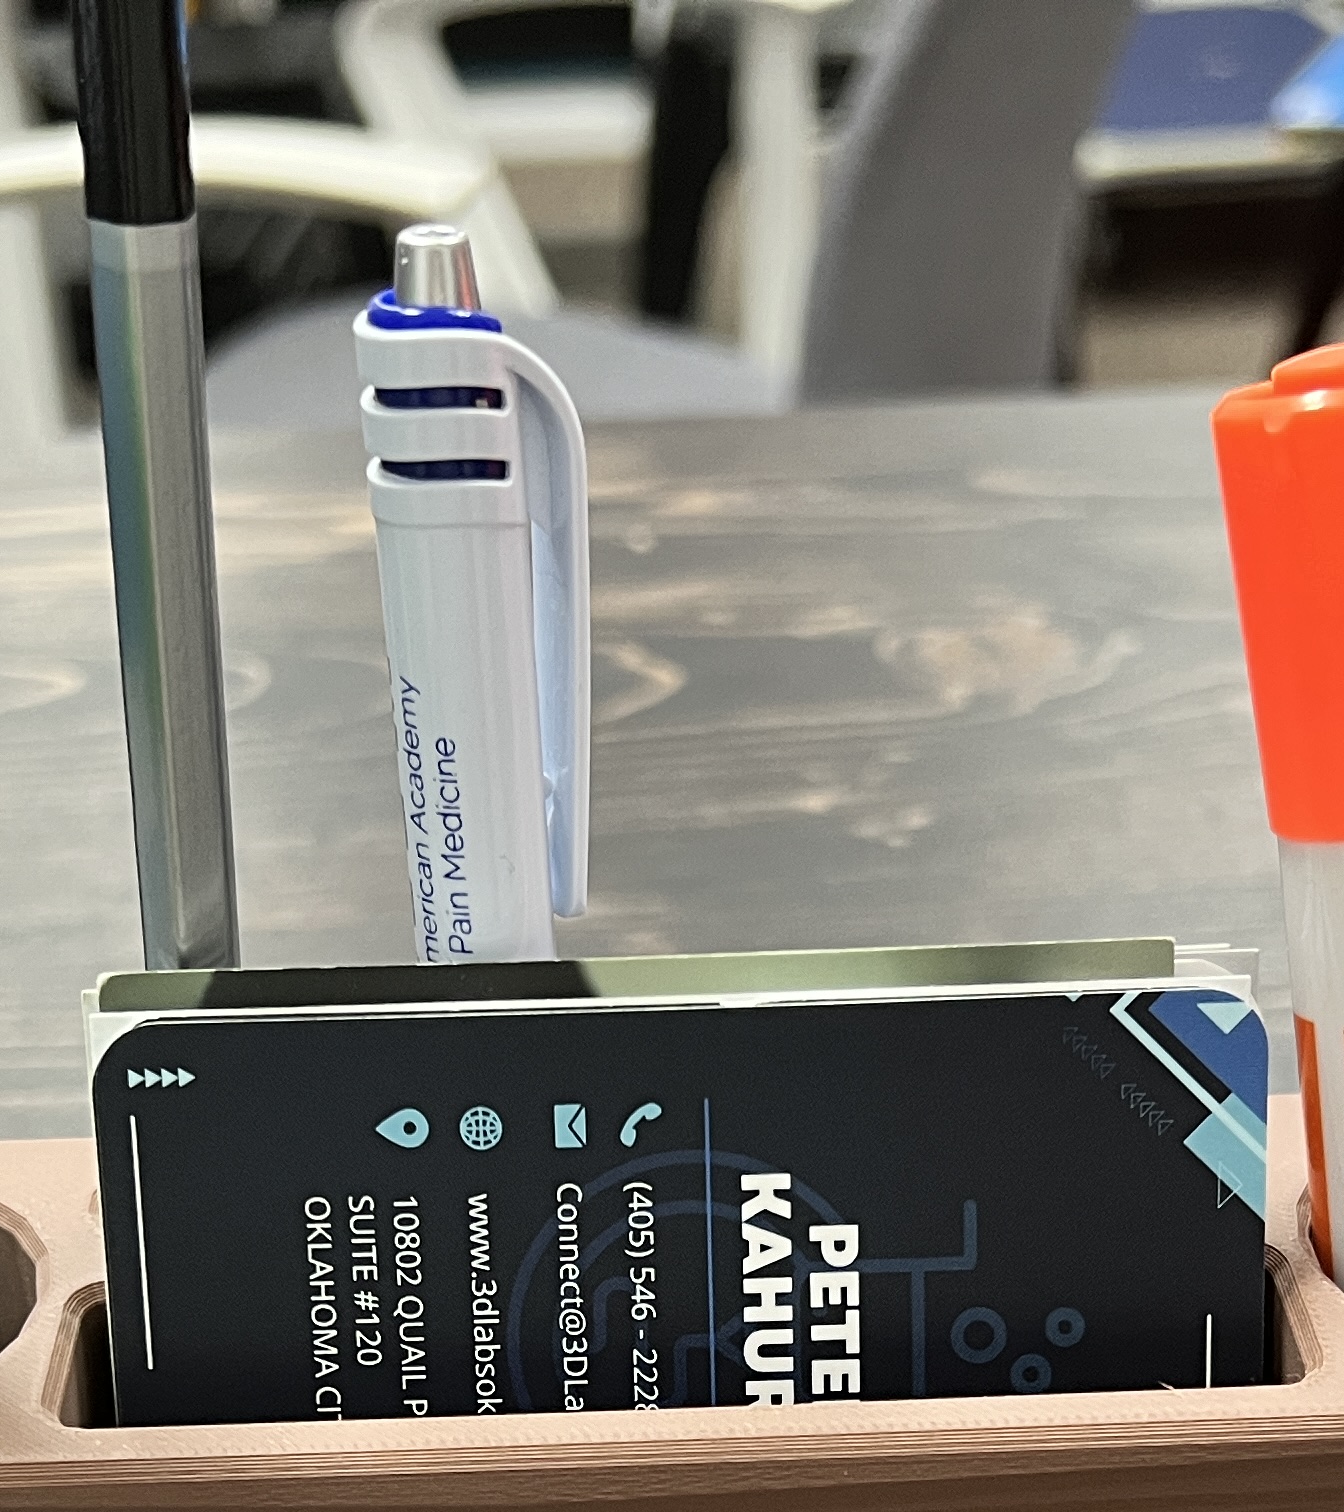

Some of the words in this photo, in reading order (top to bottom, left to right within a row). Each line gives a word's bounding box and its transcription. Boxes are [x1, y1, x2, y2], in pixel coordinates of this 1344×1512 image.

[399, 675, 427, 834] Academy
[432, 737, 466, 881] Medicine
[446, 893, 473, 954] Pain
[347, 1195, 379, 1282] SUITE
[392, 1196, 423, 1287] 10802
[622, 1181, 655, 1258] (405)
[304, 1196, 340, 1379] OKLAHOMA
[353, 1290, 383, 1366] #120
[467, 1192, 504, 1414] www.3dlabsok
[556, 1182, 589, 1412] Connect@3DLa
[629, 1266, 657, 1322] 546
[808, 1223, 861, 1403] PETE
[392, 1294, 427, 1390] QUAIL
[315, 1386, 343, 1421] CI
[402, 1399, 429, 1416] P
